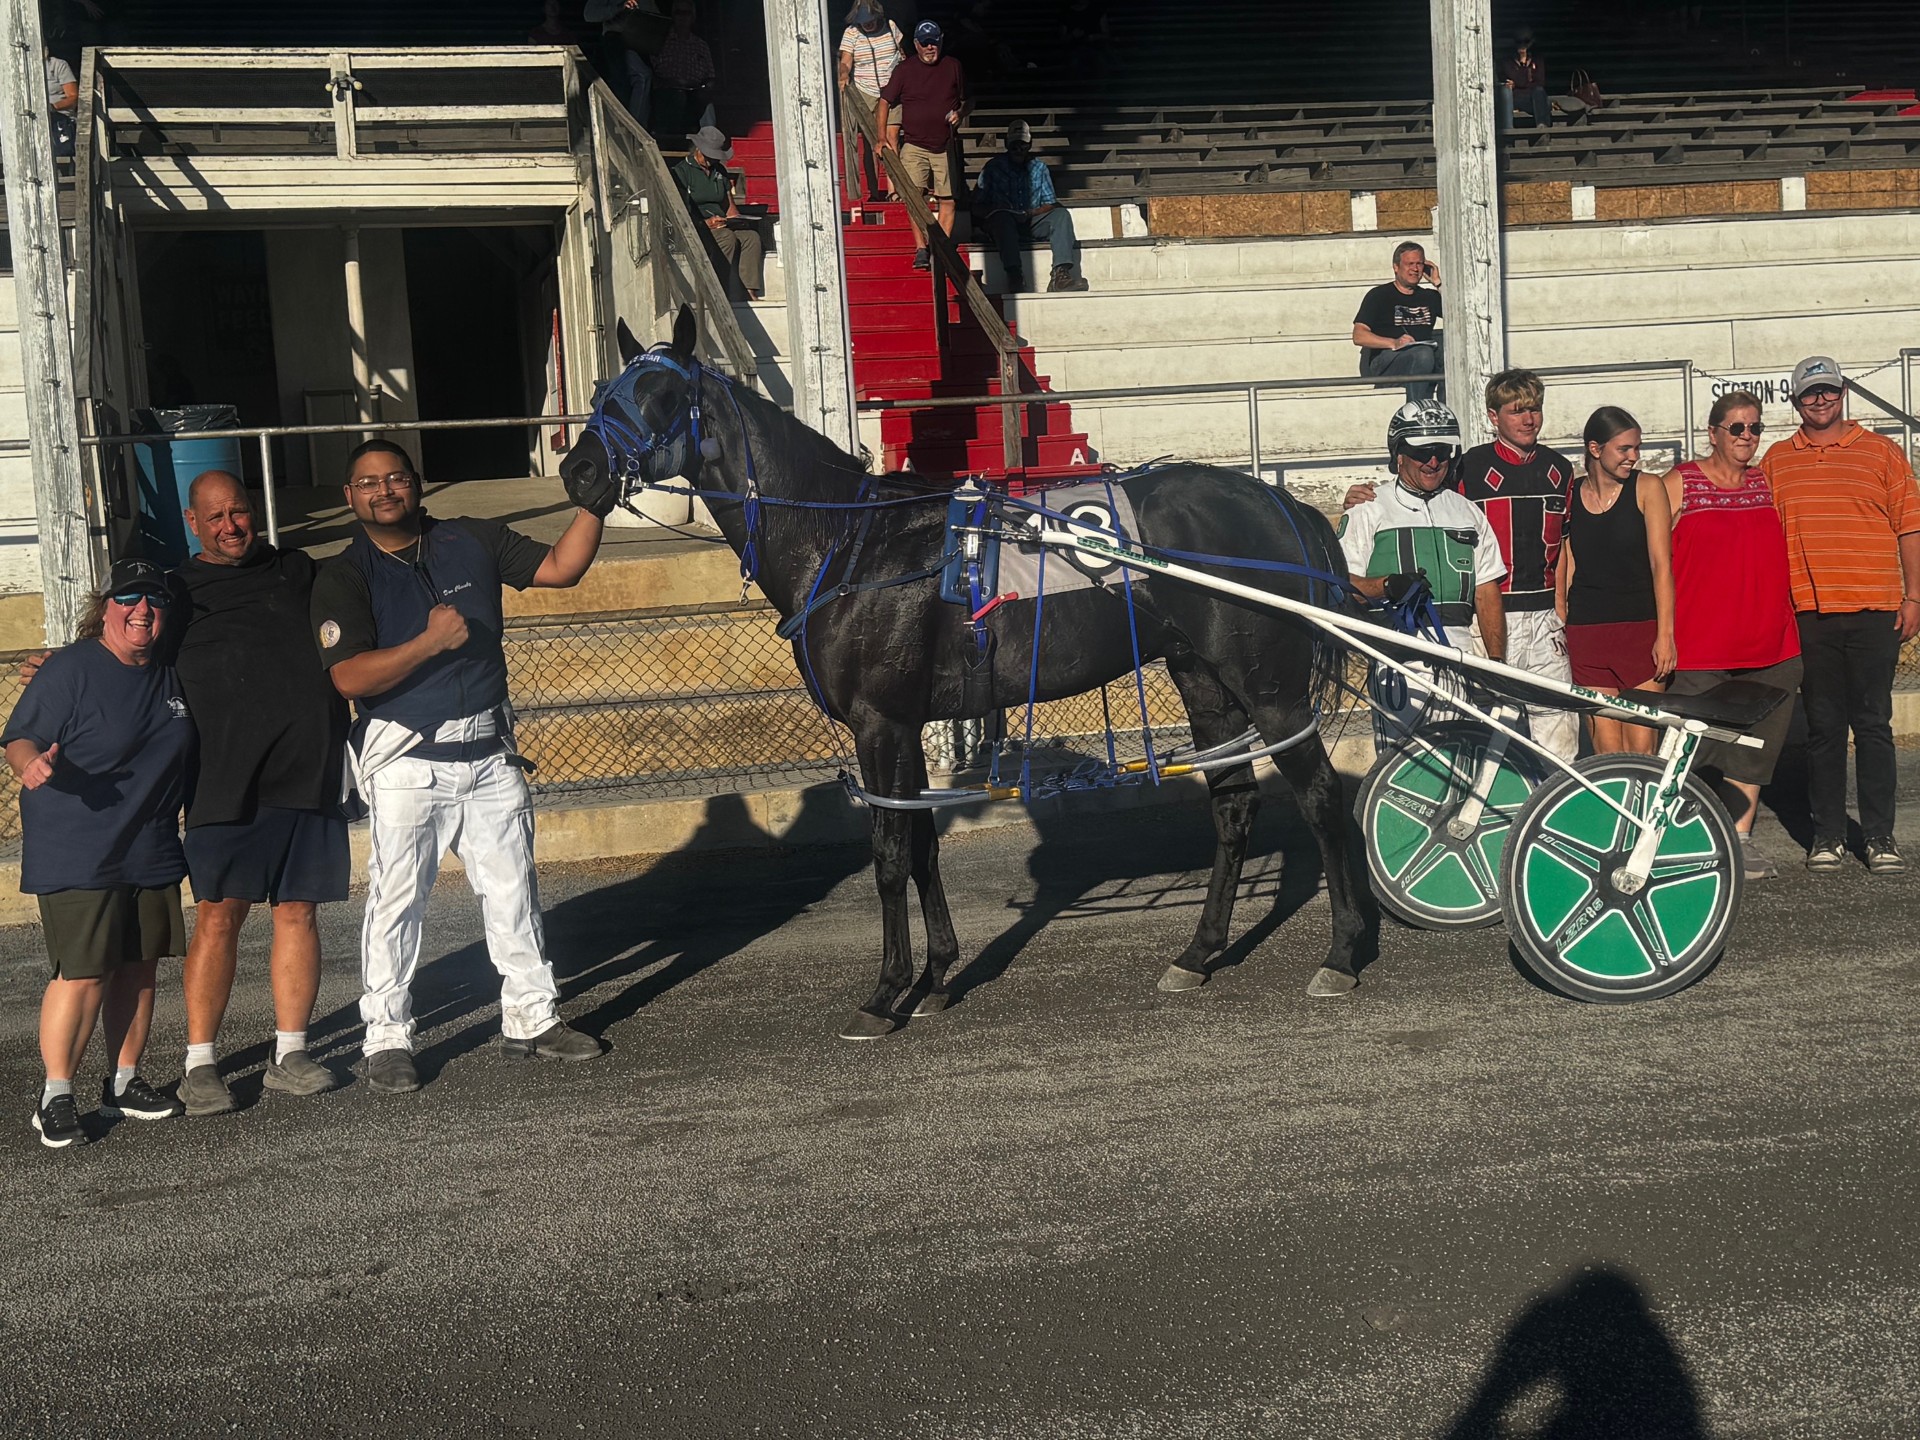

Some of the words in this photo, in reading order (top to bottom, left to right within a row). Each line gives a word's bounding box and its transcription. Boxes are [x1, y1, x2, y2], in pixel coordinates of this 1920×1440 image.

[851, 207, 862, 223] F
[1780, 379, 1790, 403] 9
[901, 456, 916, 473] A
[1070, 447, 1086, 466] A
